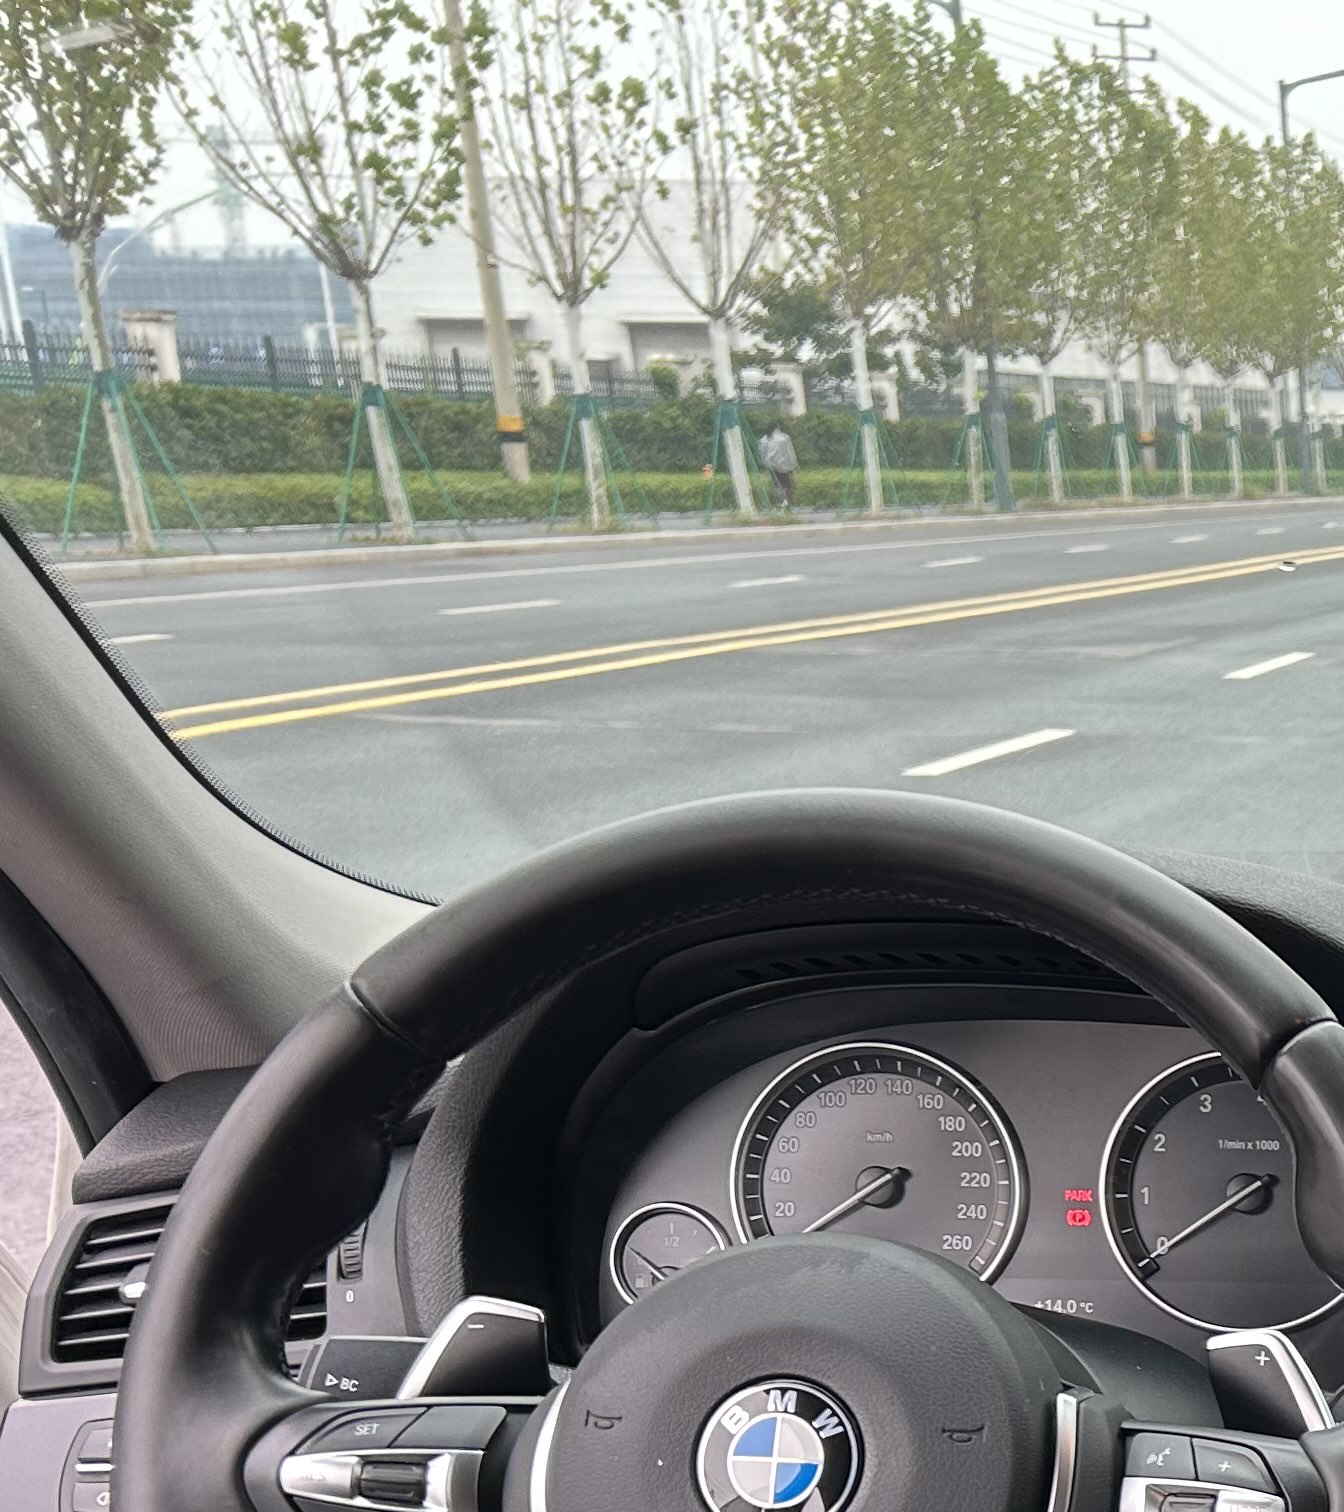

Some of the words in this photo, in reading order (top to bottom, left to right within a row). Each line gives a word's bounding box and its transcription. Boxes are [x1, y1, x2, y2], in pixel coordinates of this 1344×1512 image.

[850, 1078, 875, 1094] 120
[886, 1078, 912, 1095] 140
[819, 1091, 845, 1107] 100
[917, 1094, 943, 1110] 160
[1199, 1094, 1212, 1113] 3
[795, 1112, 816, 1128] 80
[938, 1116, 965, 1132] 180
[778, 1137, 799, 1153] 60
[866, 1131, 893, 1143] km/h
[1153, 1133, 1166, 1152] 2
[952, 1141, 982, 1157] 200
[1247, 1141, 1253, 1149] x
[1256, 1140, 1280, 1151] 1000
[770, 1168, 791, 1184] 40
[960, 1172, 990, 1188] 220
[1064, 1189, 1093, 1202] PARK
[1140, 1186, 1149, 1205] 1
[774, 1201, 795, 1217] 20
[957, 1204, 987, 1220] 240
[663, 1236, 680, 1247] 1/2
[942, 1235, 973, 1251] 260
[1156, 1236, 1169, 1255] 0
[340, 1377, 360, 1392] BC
[720, 1389, 844, 1439] BMW
[354, 1423, 380, 1436] SET
